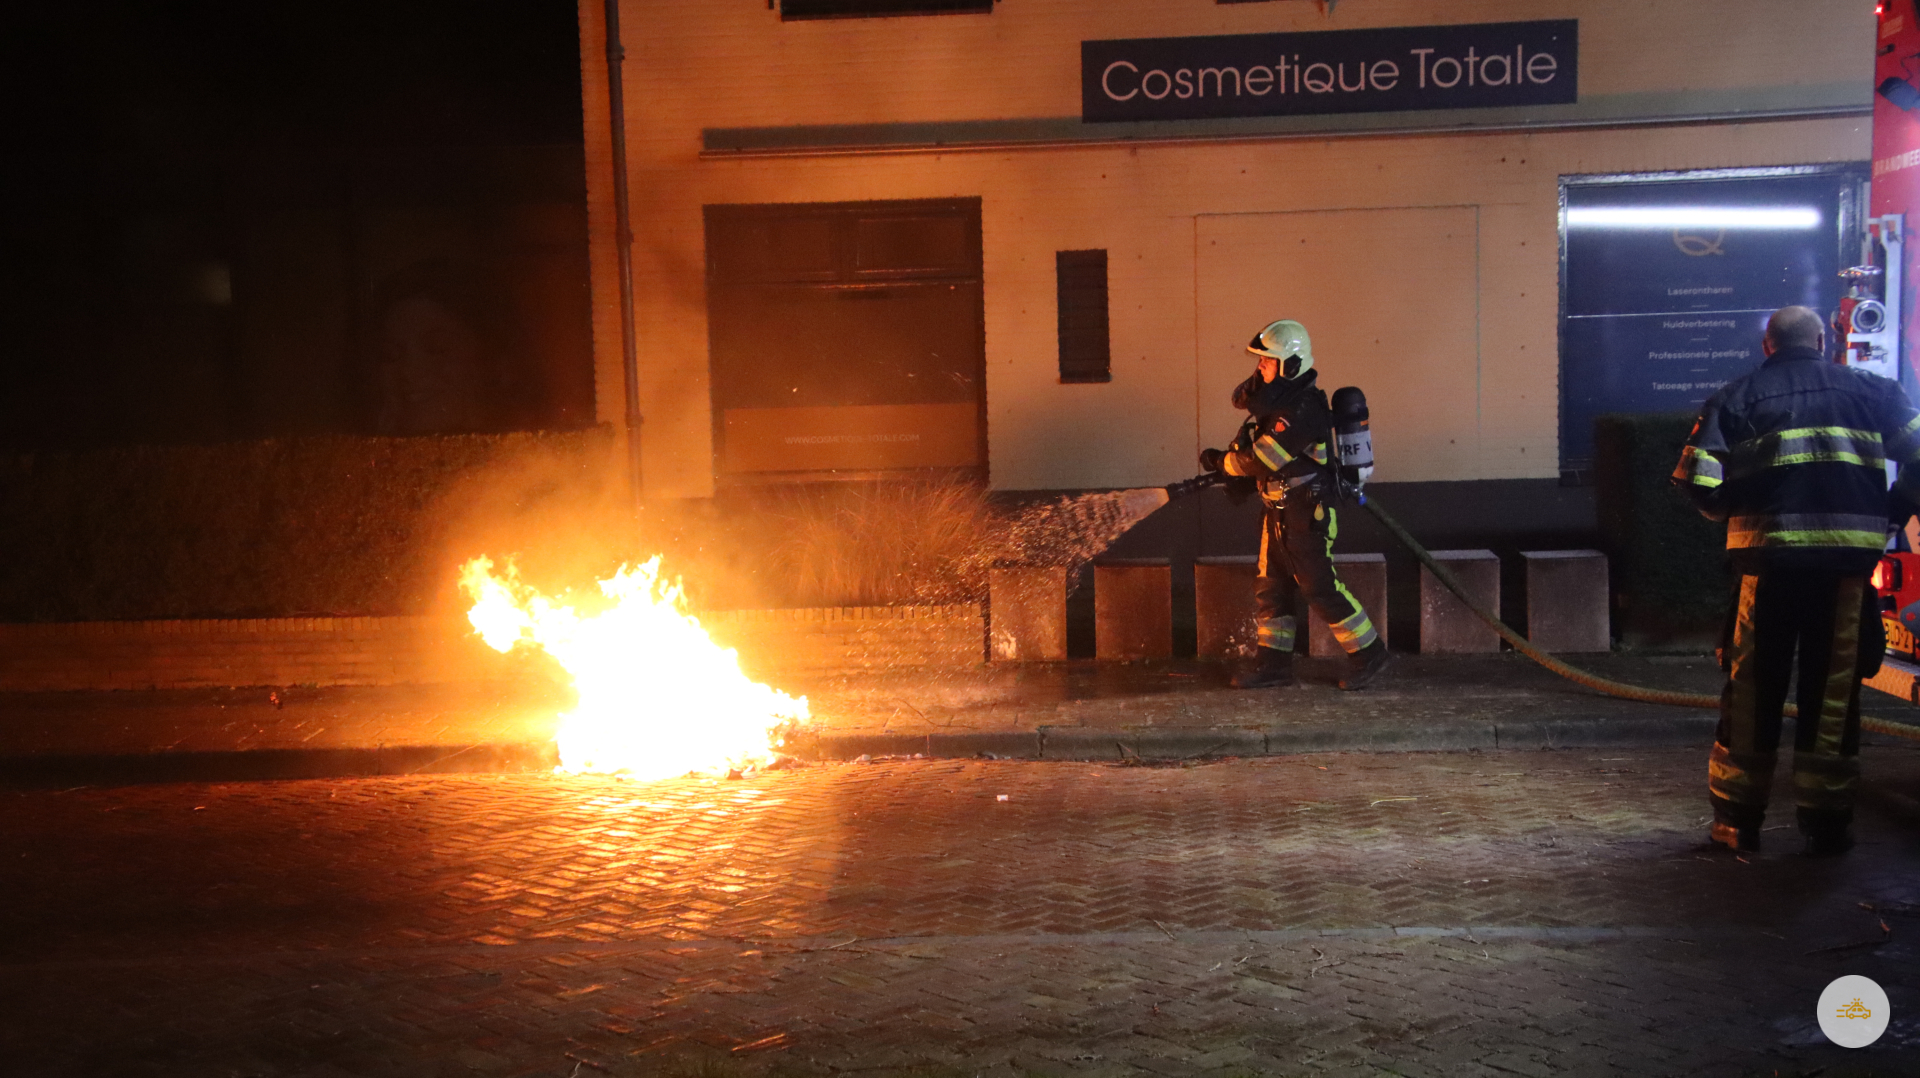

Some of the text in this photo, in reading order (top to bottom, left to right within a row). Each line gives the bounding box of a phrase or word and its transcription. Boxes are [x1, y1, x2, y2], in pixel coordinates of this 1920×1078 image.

[1101, 44, 1558, 102] Cosmetique Totale
[1667, 285, 1734, 297] Laserontharen
[1662, 318, 1736, 330] Huidverbetering
[1648, 348, 1751, 360] Professionele peelings
[1652, 381, 1693, 392] Tatoeage
